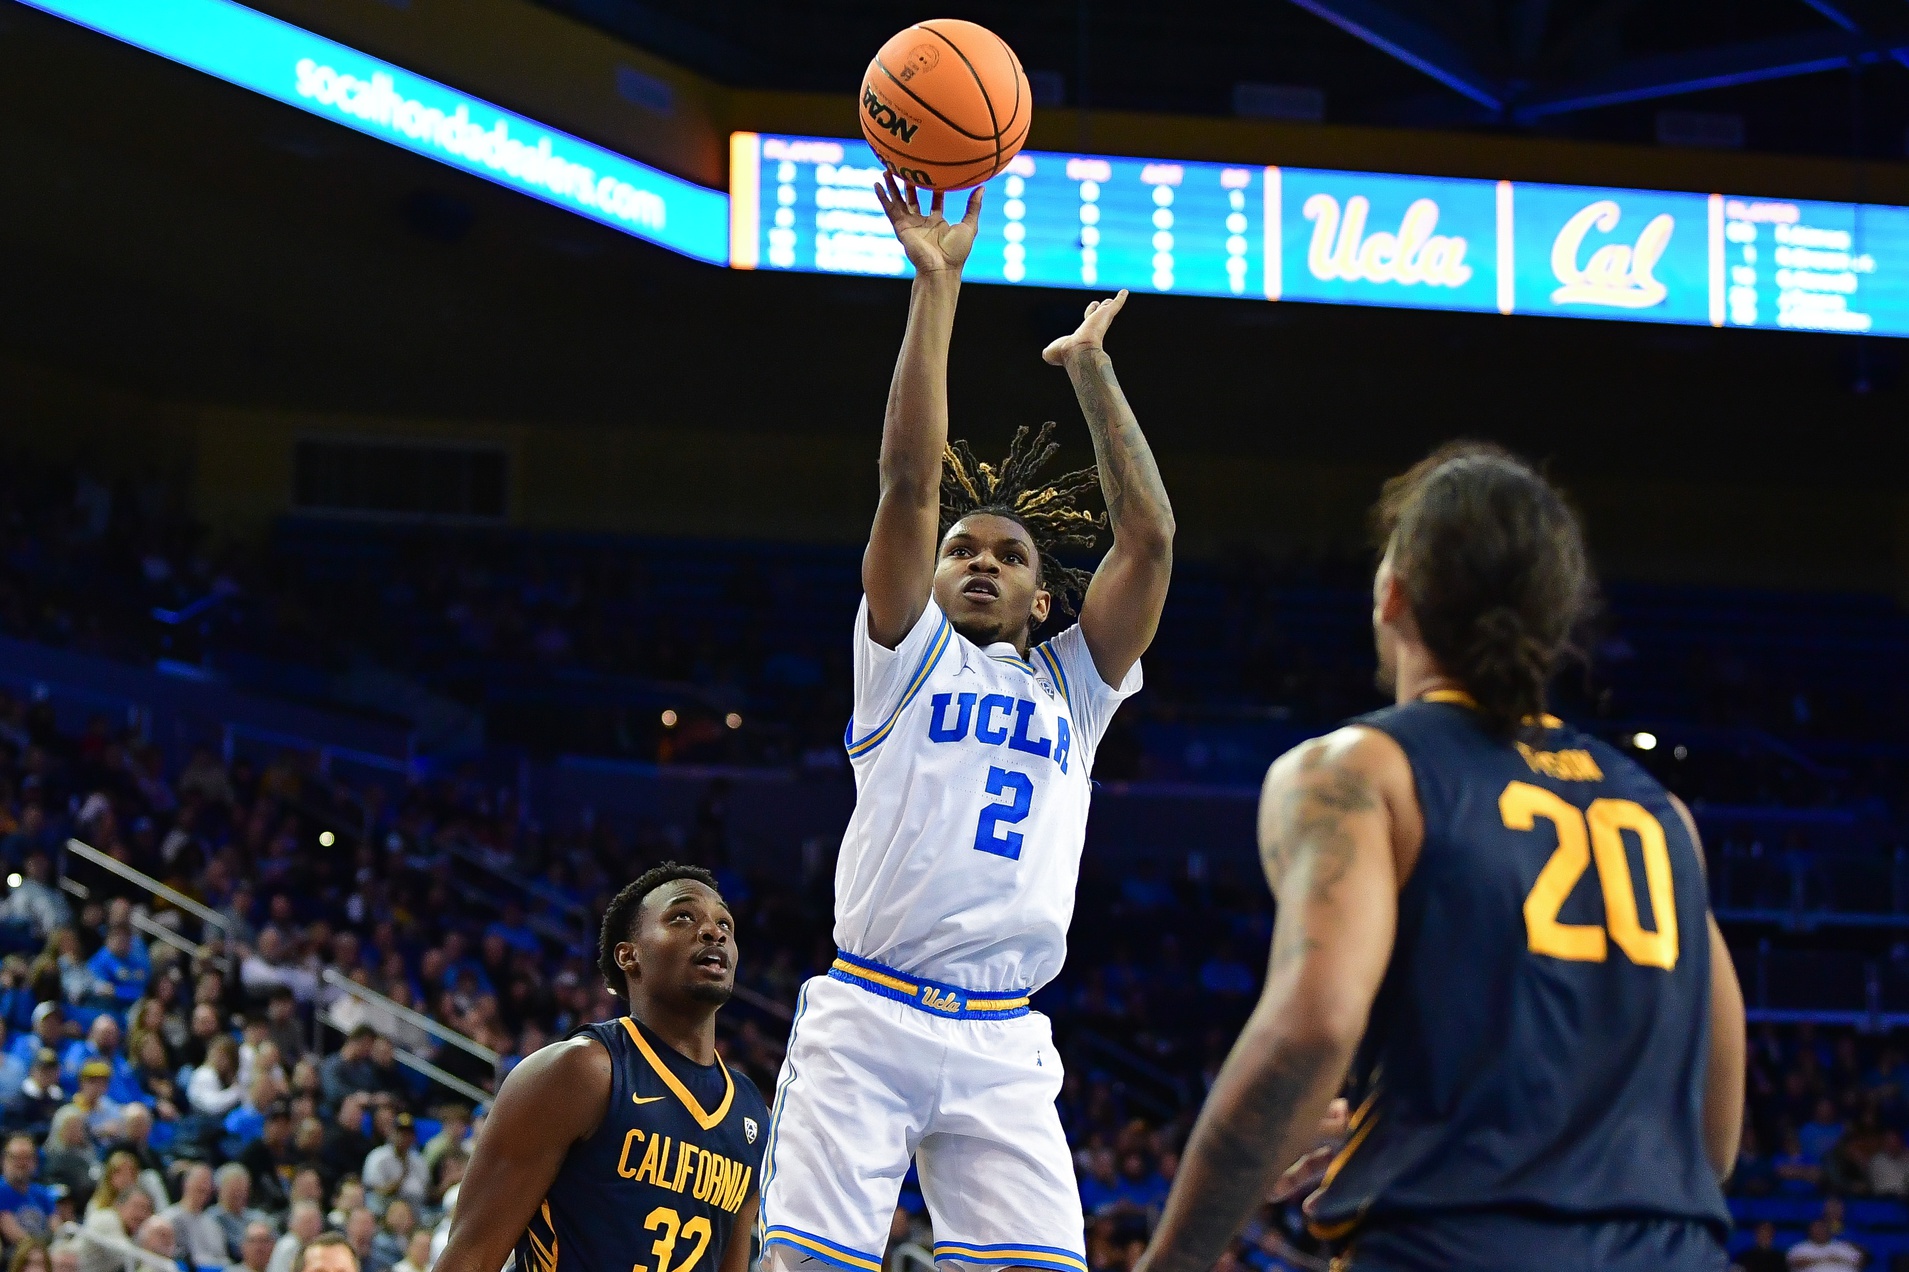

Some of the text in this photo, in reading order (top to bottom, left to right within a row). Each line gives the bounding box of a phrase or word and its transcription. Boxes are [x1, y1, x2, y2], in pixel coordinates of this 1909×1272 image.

[297, 59, 665, 228] socalhondadealers.com
[863, 81, 919, 145] NCAA
[1551, 200, 1675, 308] Cal
[928, 692, 1070, 775] UCLA
[973, 765, 1034, 861] 2
[1498, 780, 1679, 971] 20
[617, 1128, 752, 1214] CALIFORNIA
[633, 1206, 712, 1272] 32
